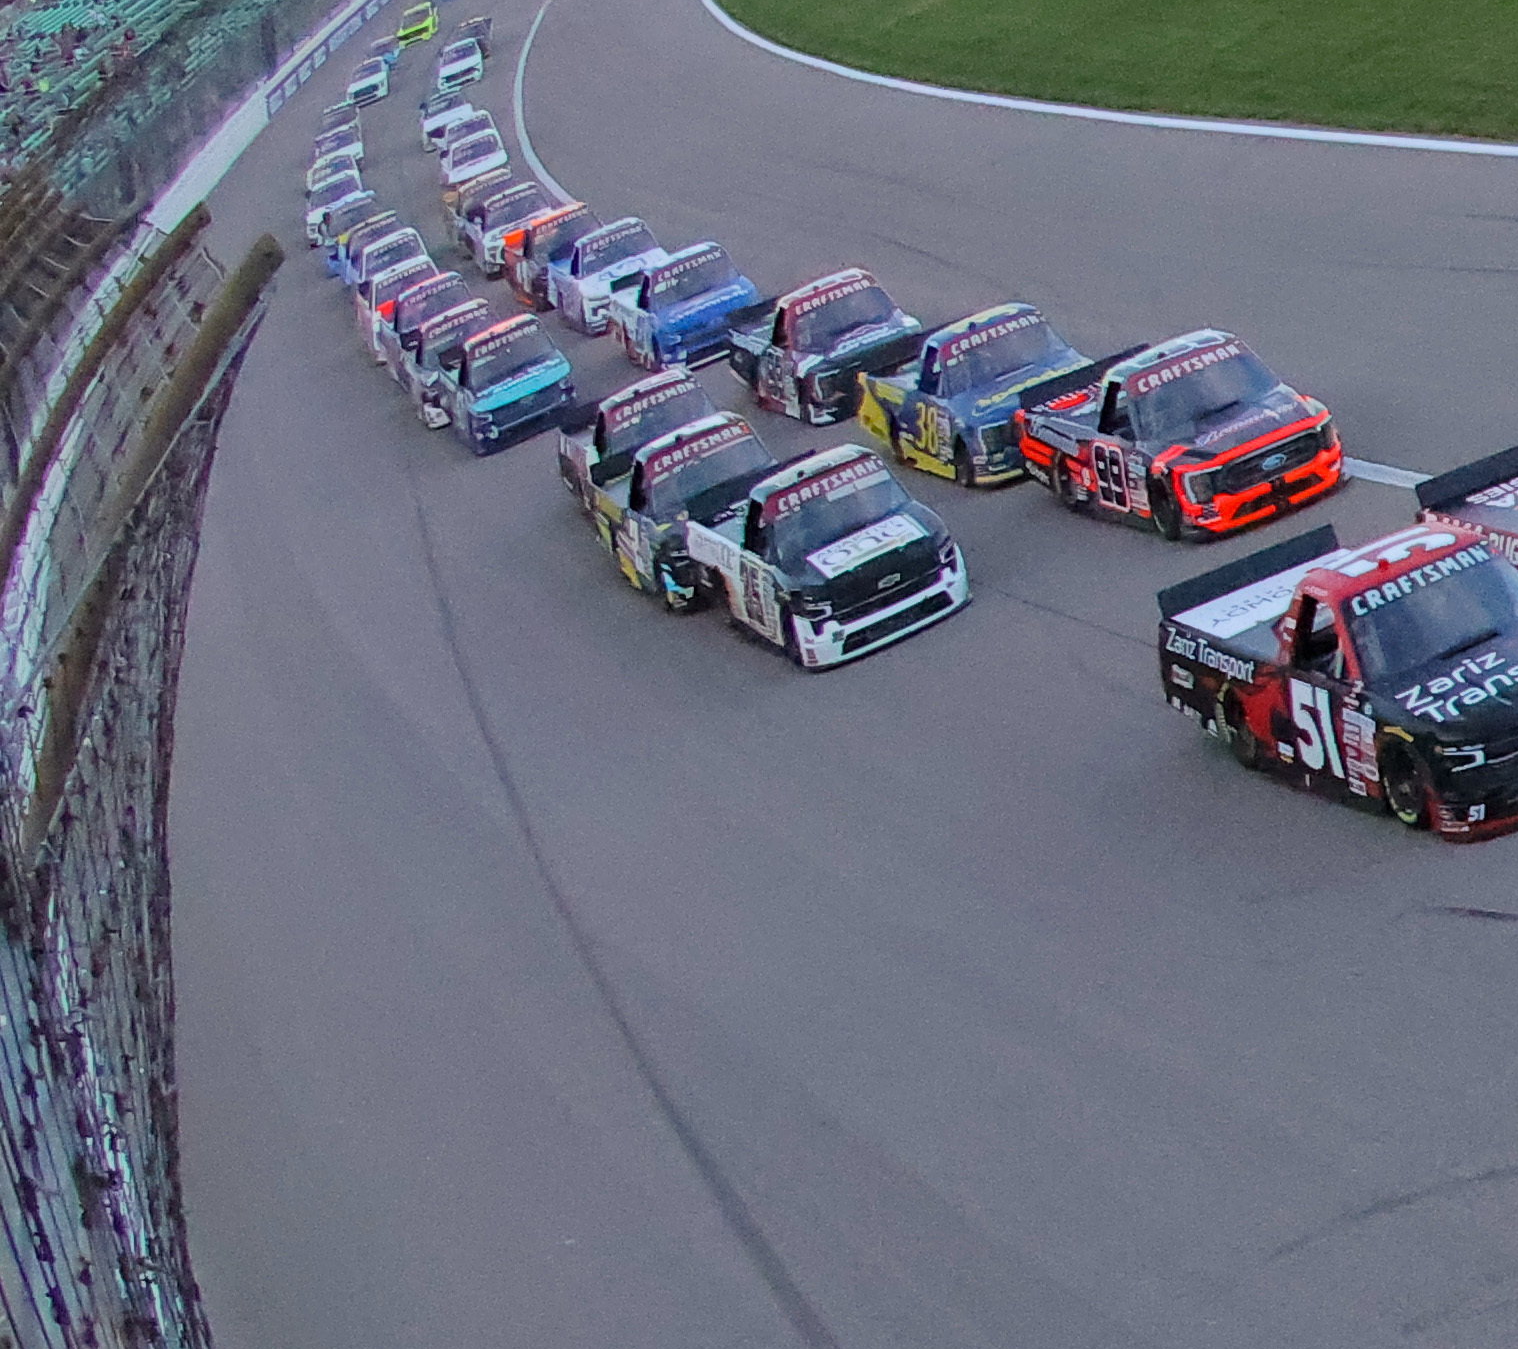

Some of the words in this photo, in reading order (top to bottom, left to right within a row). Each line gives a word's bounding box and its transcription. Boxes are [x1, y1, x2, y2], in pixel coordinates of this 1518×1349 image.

[1137, 344, 1241, 392] CRAFTSMAN
[777, 459, 879, 512] CRAFTSMAN
[1351, 544, 1491, 617] CRAFTSMAN
[1165, 626, 1197, 661] Zariz
[1197, 638, 1255, 684] Transport
[1395, 651, 1506, 711] Zariz
[1289, 677, 1346, 779] 51
[1468, 803, 1487, 822] 51
